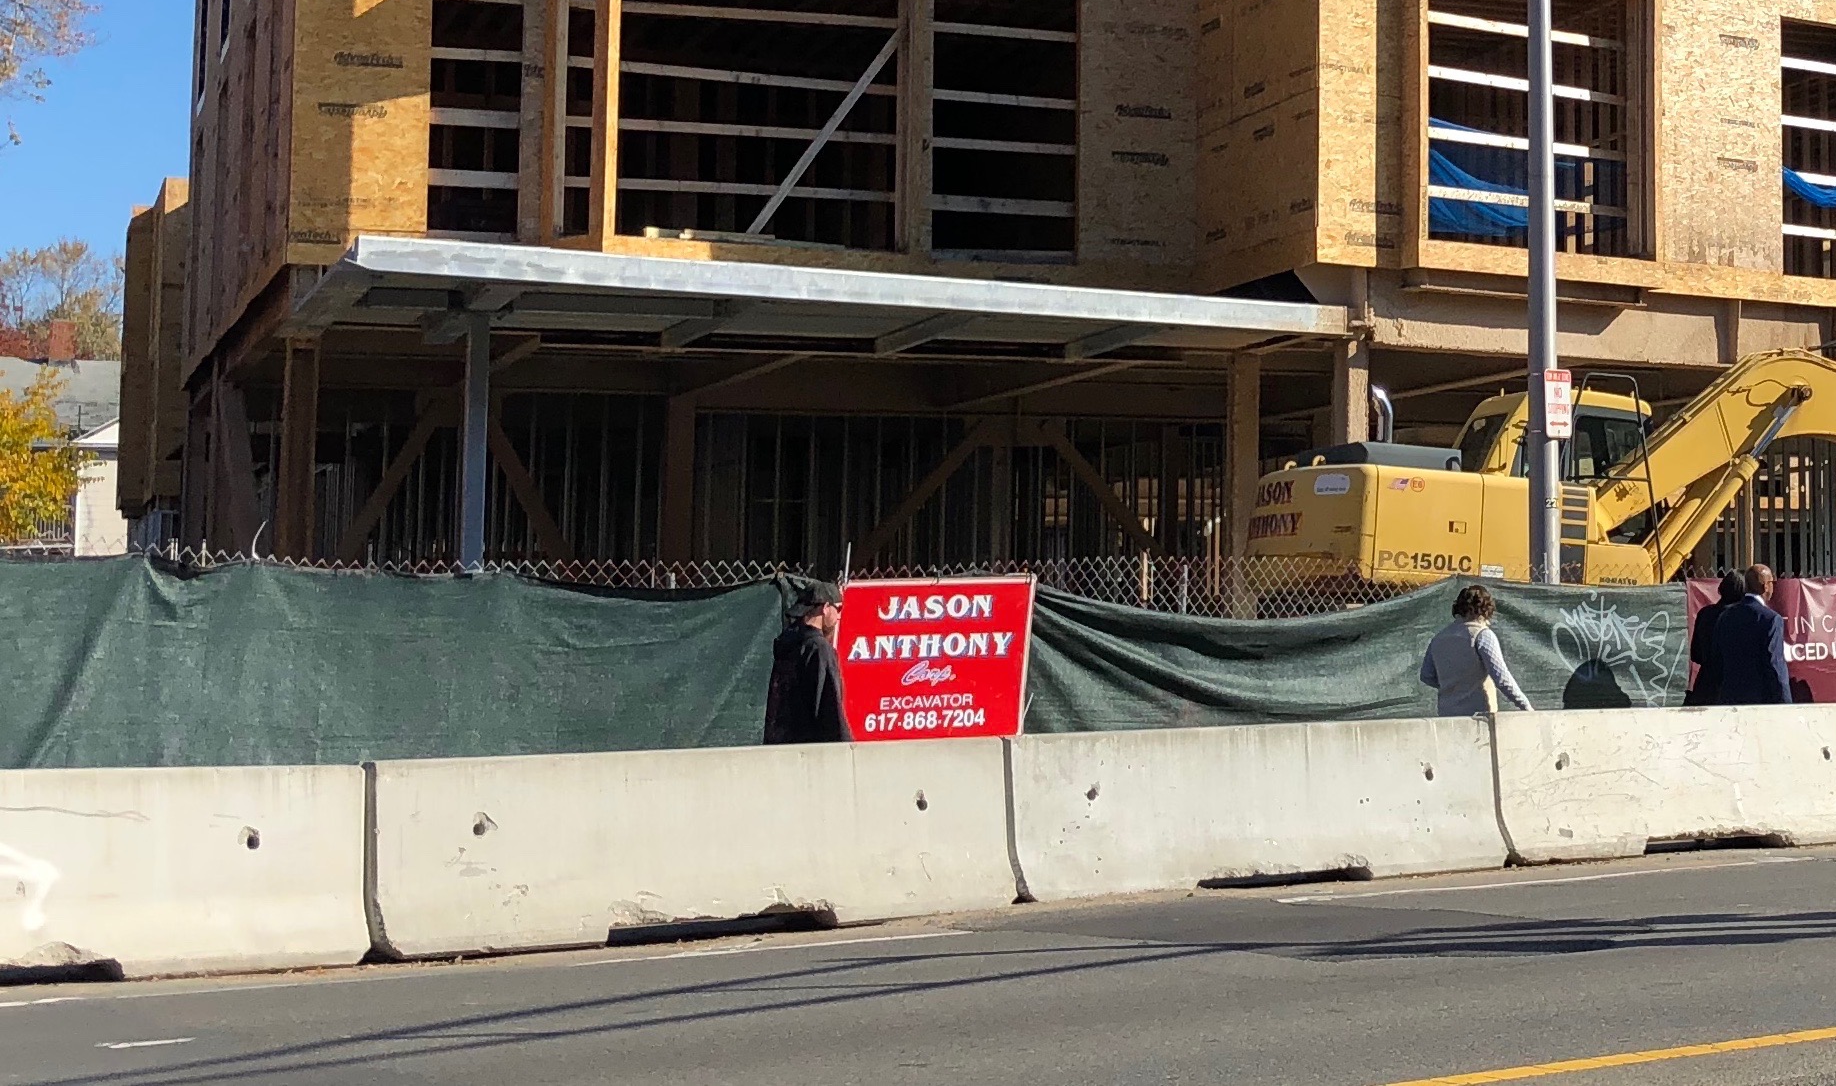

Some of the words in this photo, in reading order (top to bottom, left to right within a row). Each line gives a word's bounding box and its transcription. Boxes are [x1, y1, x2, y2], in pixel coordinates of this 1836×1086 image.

[1378, 550, 1472, 572] PC150LC
[878, 594, 993, 620] JASON
[1795, 616, 1815, 634] IN
[848, 632, 1014, 660] ANTHONY
[901, 660, 956, 686] Corp.
[880, 693, 973, 710] EXCAVATOR
